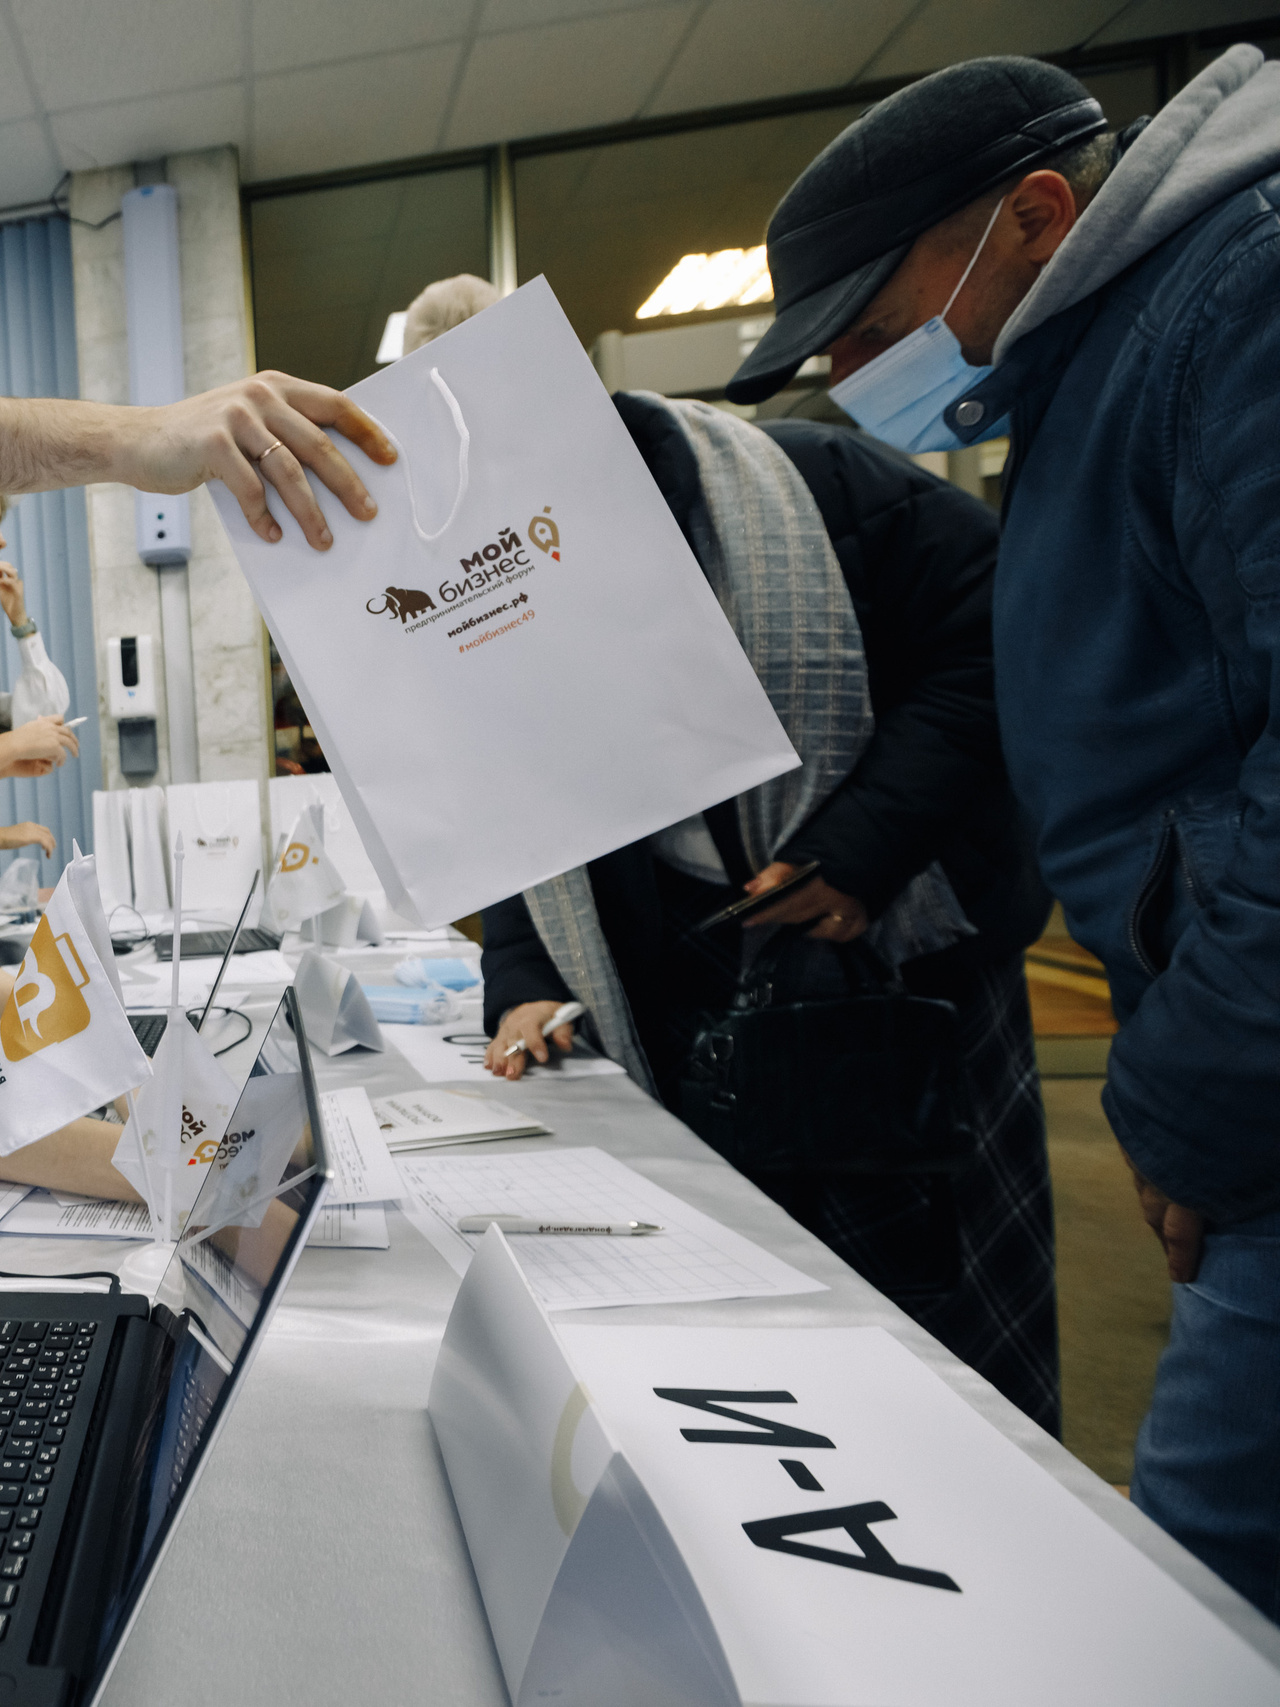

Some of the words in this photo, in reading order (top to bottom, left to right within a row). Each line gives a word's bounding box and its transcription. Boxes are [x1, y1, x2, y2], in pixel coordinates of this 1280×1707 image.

[404, 579, 504, 634] предпринимательский
[505, 564, 536, 585] форум
[438, 549, 531, 603] бизнес
[447, 592, 529, 638] мойбизнес.рф
[458, 609, 536, 654] #мойбизнес49
